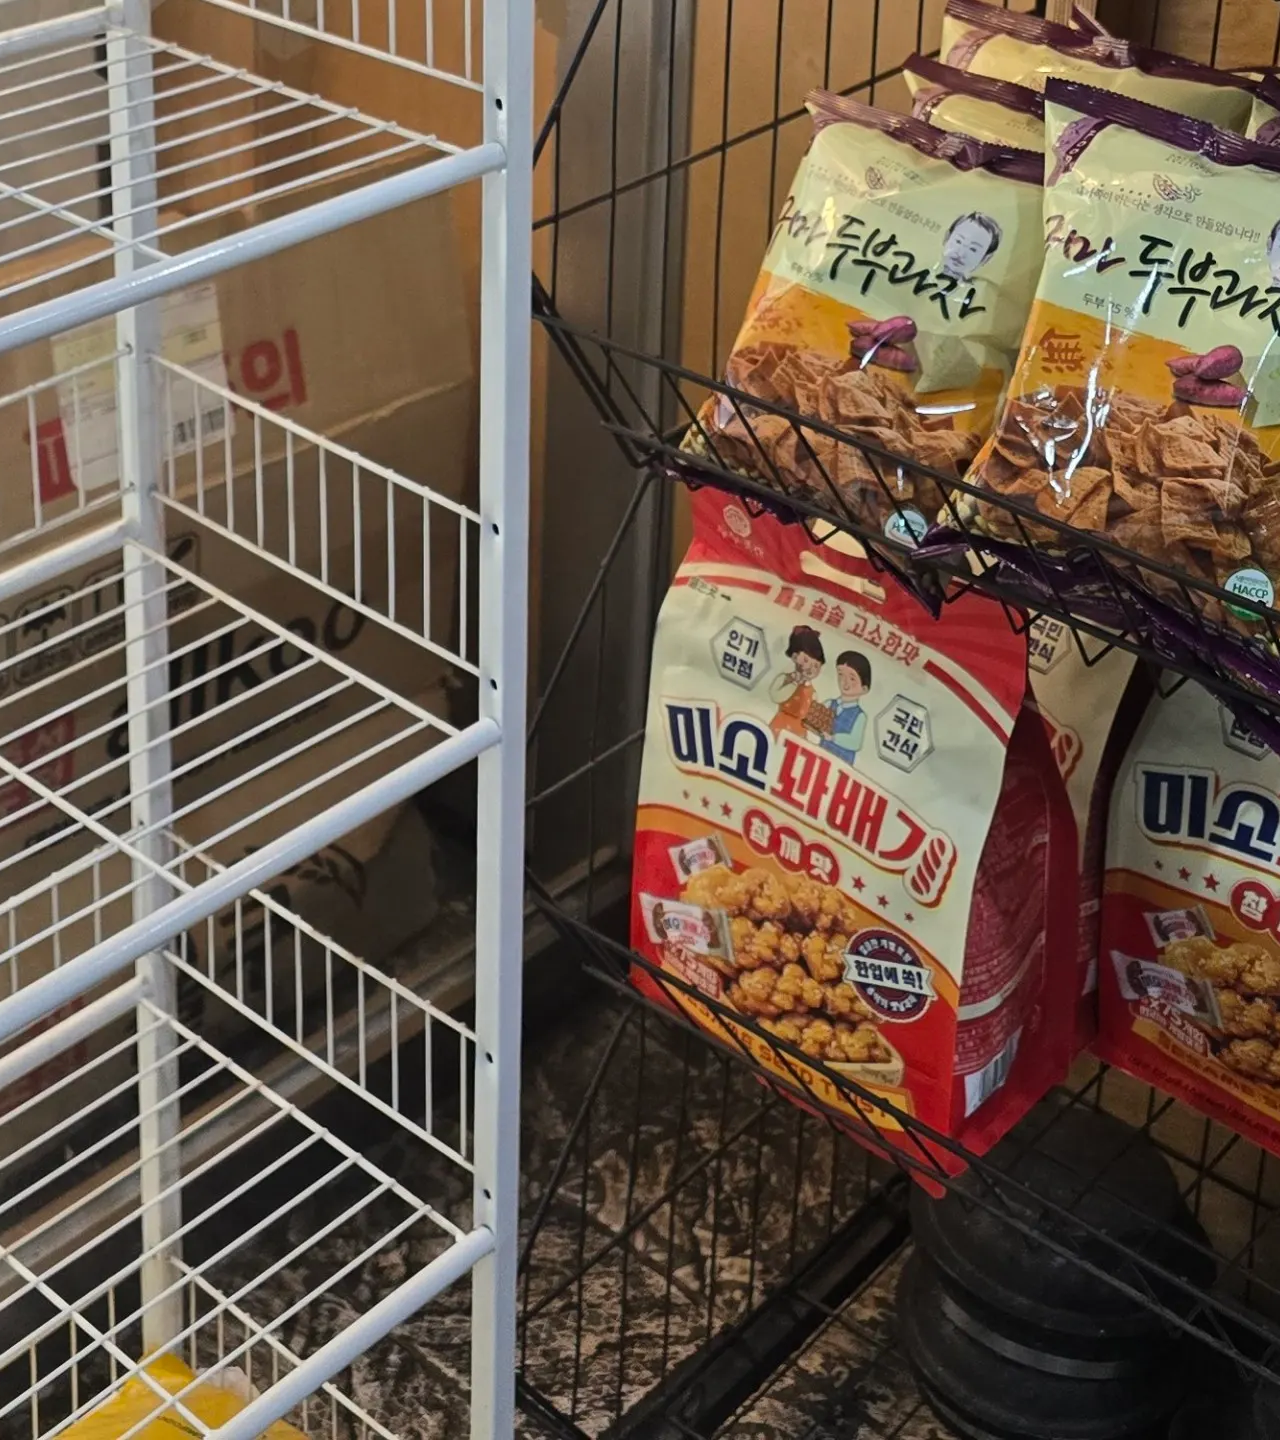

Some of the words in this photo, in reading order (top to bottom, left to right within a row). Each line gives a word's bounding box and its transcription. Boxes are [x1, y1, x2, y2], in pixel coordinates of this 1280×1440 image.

[826, 215, 986, 321] 두부과자
[726, 628, 760, 658] 인기
[808, 597, 846, 630] 솔솔
[846, 612, 921, 668] 고소한맛
[721, 651, 754, 680] 만점
[891, 706, 925, 738] 국민
[881, 730, 920, 762] 간식
[853, 959, 900, 985] 한입에
